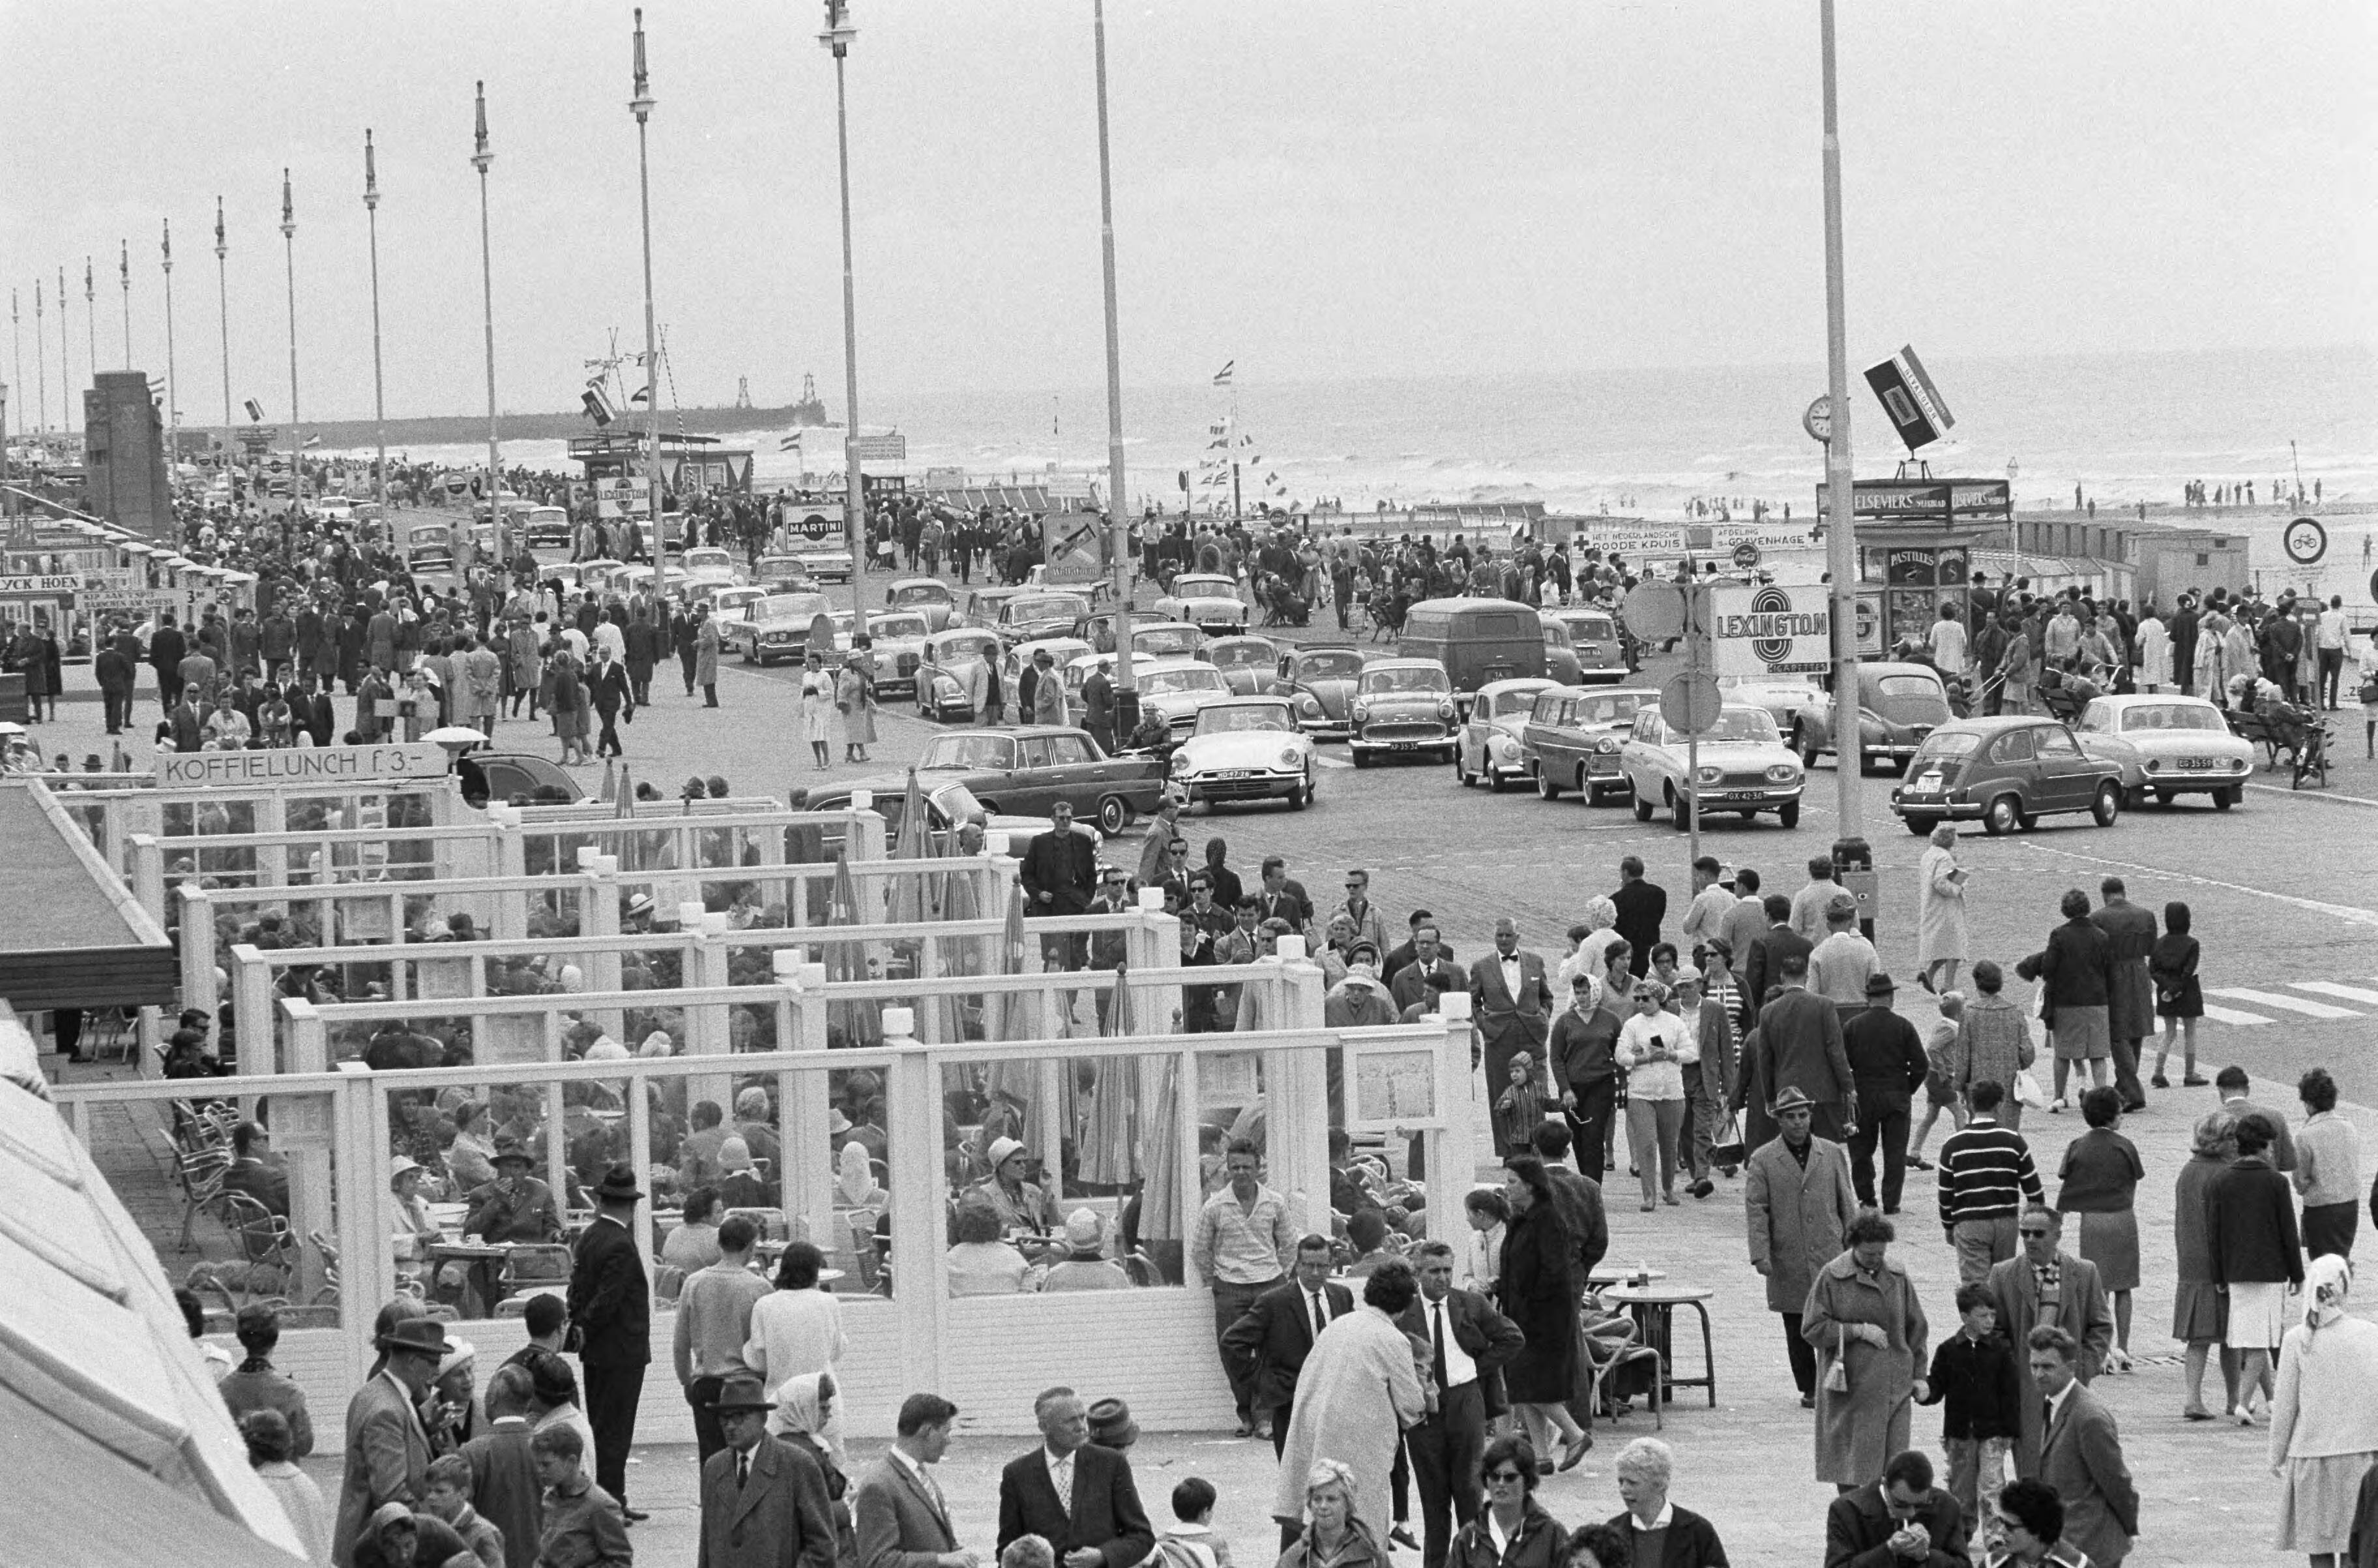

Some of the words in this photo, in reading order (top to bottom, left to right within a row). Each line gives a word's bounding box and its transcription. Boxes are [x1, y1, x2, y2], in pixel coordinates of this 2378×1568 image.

[1855, 494, 1913, 508] ELSEVIERS
[790, 522, 841, 532] MARTINI
[1613, 530, 1680, 540] NEDERLANDSCHE
[1593, 541, 1637, 551] ROODE
[1641, 540, 1681, 549] KRUIS
[1891, 551, 1934, 566] PASTILLES
[0, 578, 32, 590] YCK
[41, 577, 78, 588] HOEN
[1718, 613, 1827, 639] LEXINGTON
[1767, 662, 1826, 673] CIGARETTES
[166, 753, 357, 781] KOFFIELUNCH
